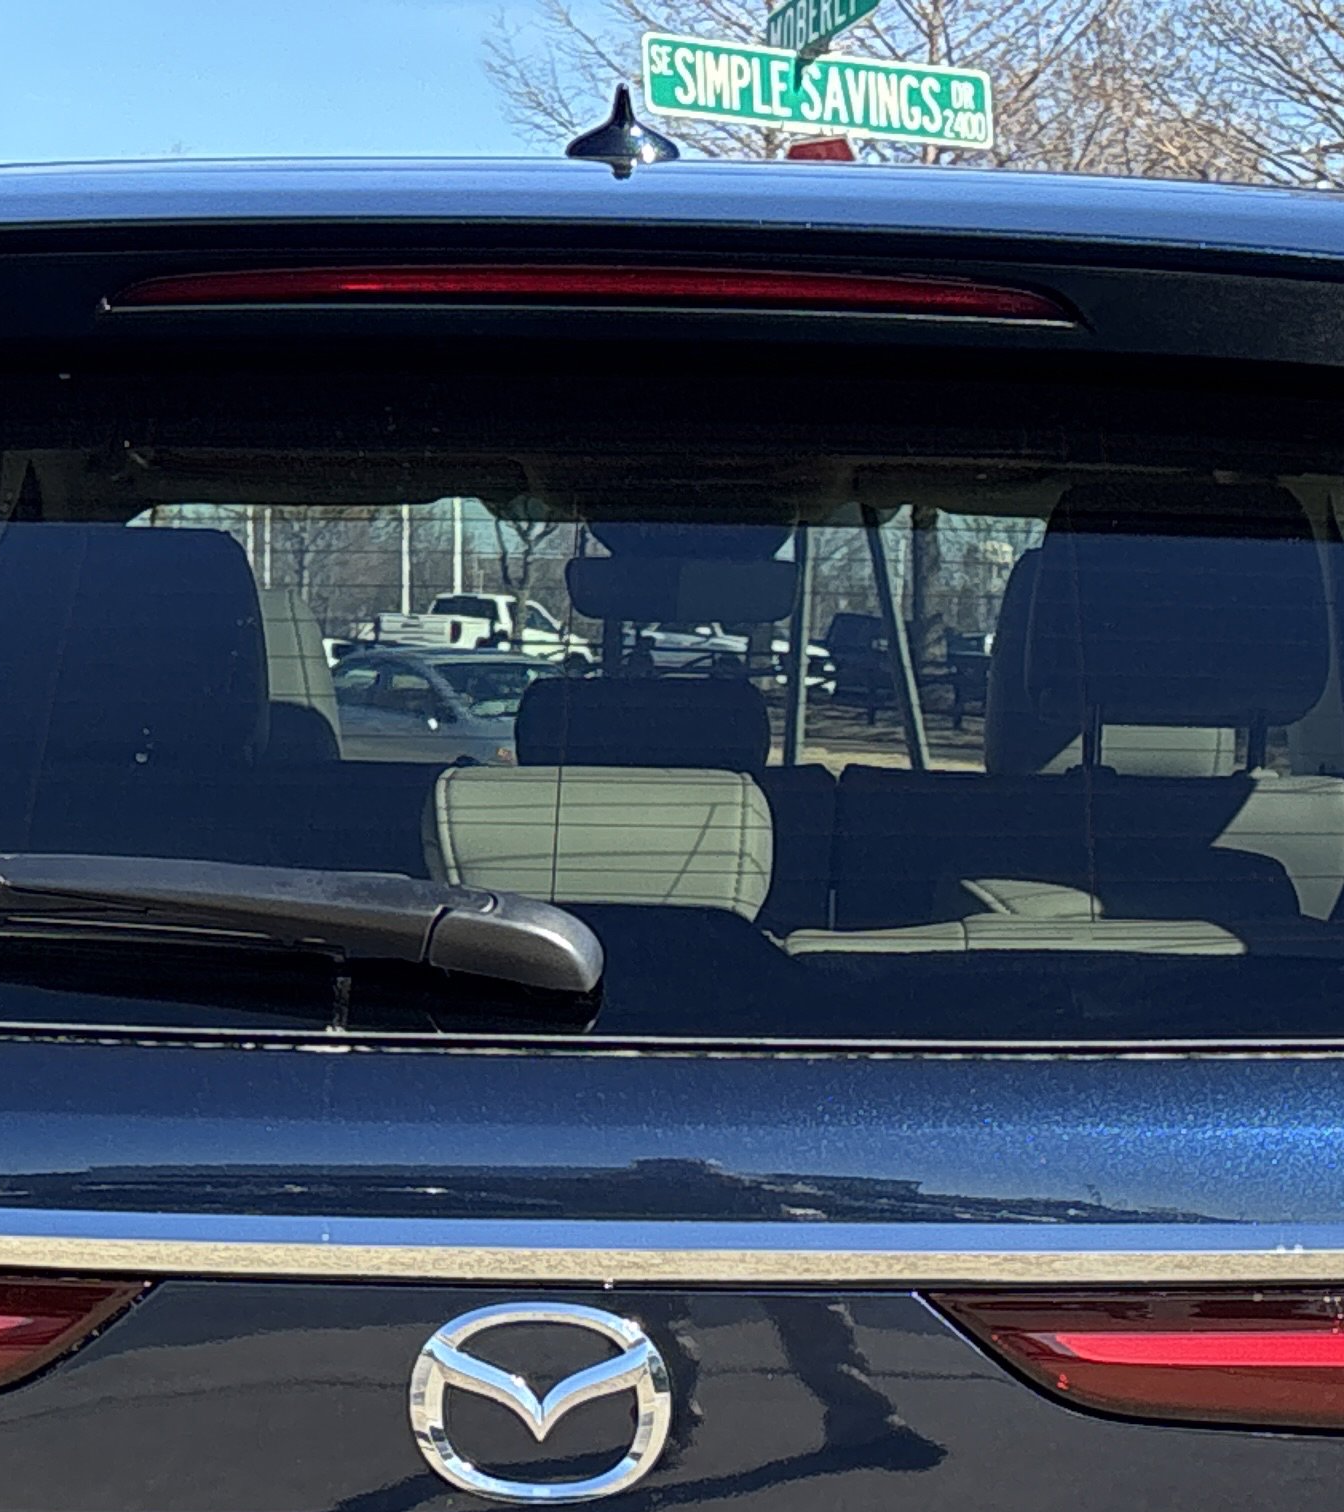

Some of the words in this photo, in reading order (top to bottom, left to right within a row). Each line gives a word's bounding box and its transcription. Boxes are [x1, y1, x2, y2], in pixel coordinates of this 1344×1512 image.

[650, 44, 674, 77] SE
[674, 48, 792, 118] SIMPLE
[800, 62, 943, 133] SAVINGS
[951, 81, 975, 111] DR
[942, 108, 986, 142] 2400
